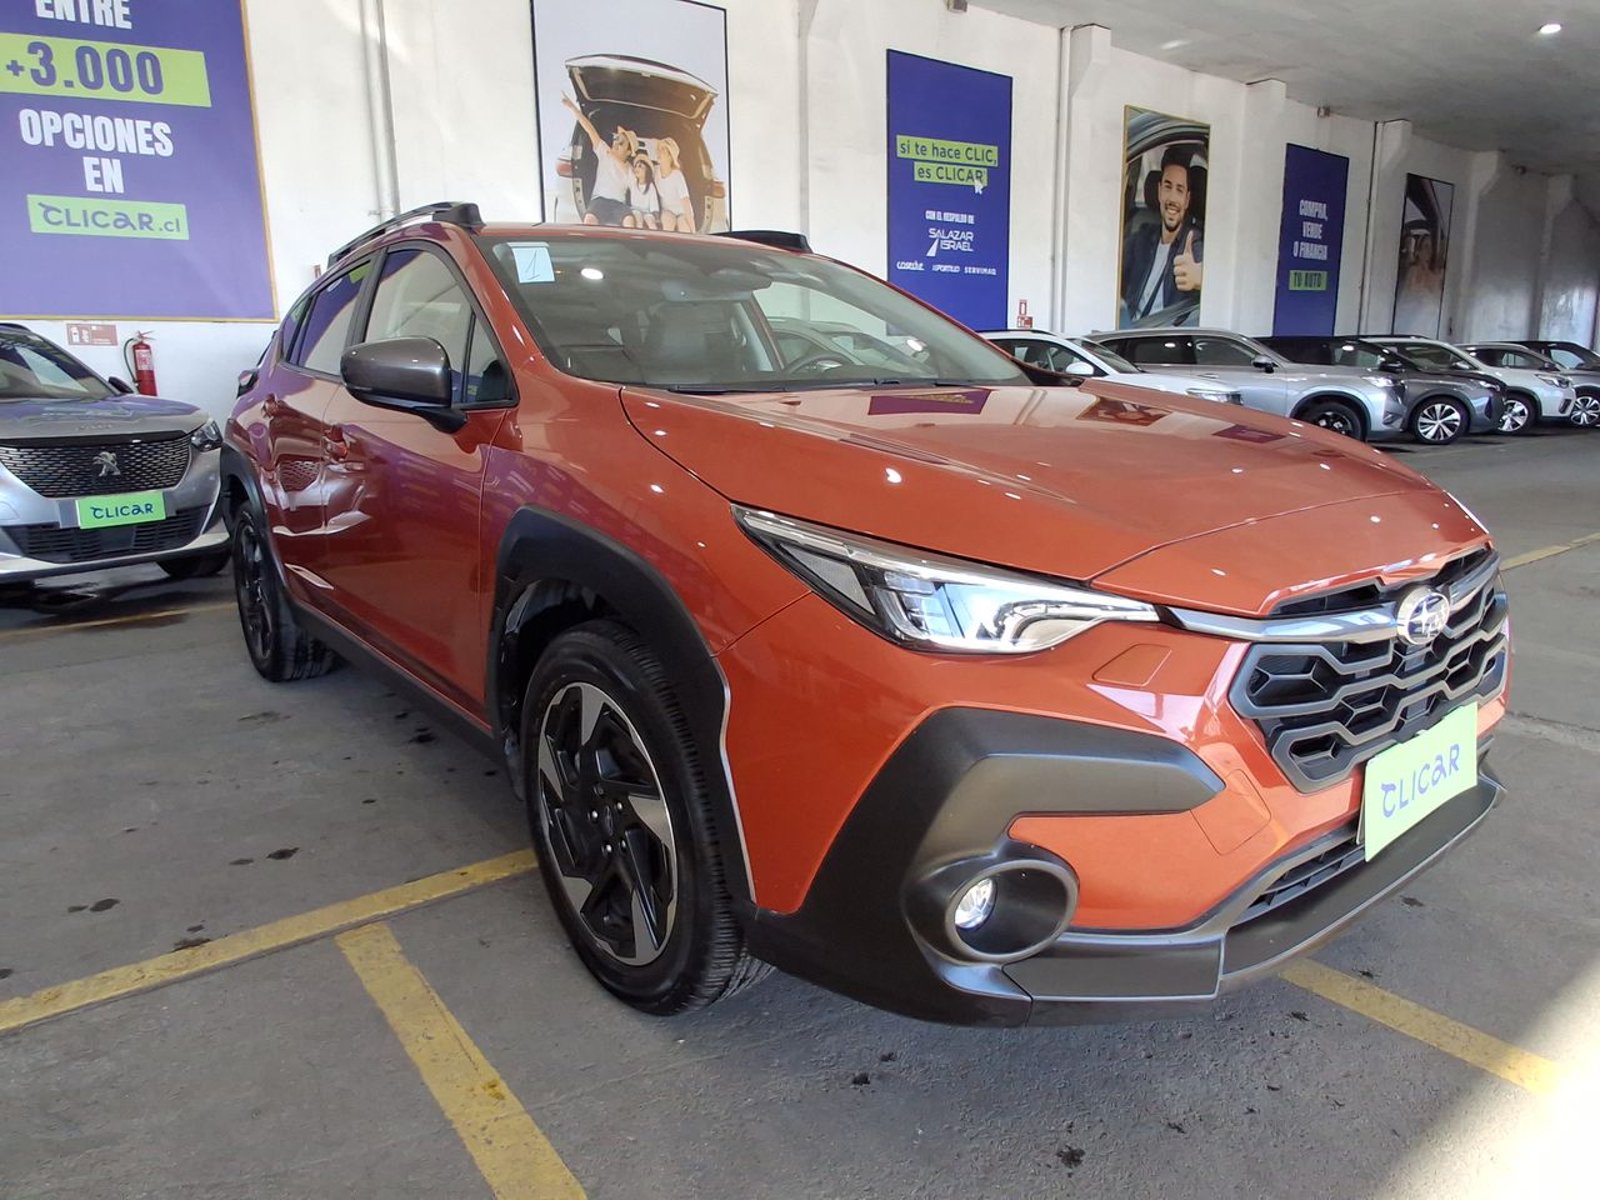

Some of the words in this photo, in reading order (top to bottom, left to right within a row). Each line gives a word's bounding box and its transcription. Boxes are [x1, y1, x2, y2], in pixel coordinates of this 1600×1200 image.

[35, 0, 132, 29] ENTRE
[4, 41, 164, 95] +3.000
[19, 108, 174, 157] OPCIONES
[900, 140, 910, 154] si
[915, 142, 928, 156] te
[932, 142, 961, 160] hace
[83, 156, 124, 193] EN
[917, 167, 932, 179] es
[928, 228, 974, 242] SALAZAR
[940, 239, 974, 252] ISRAEL
